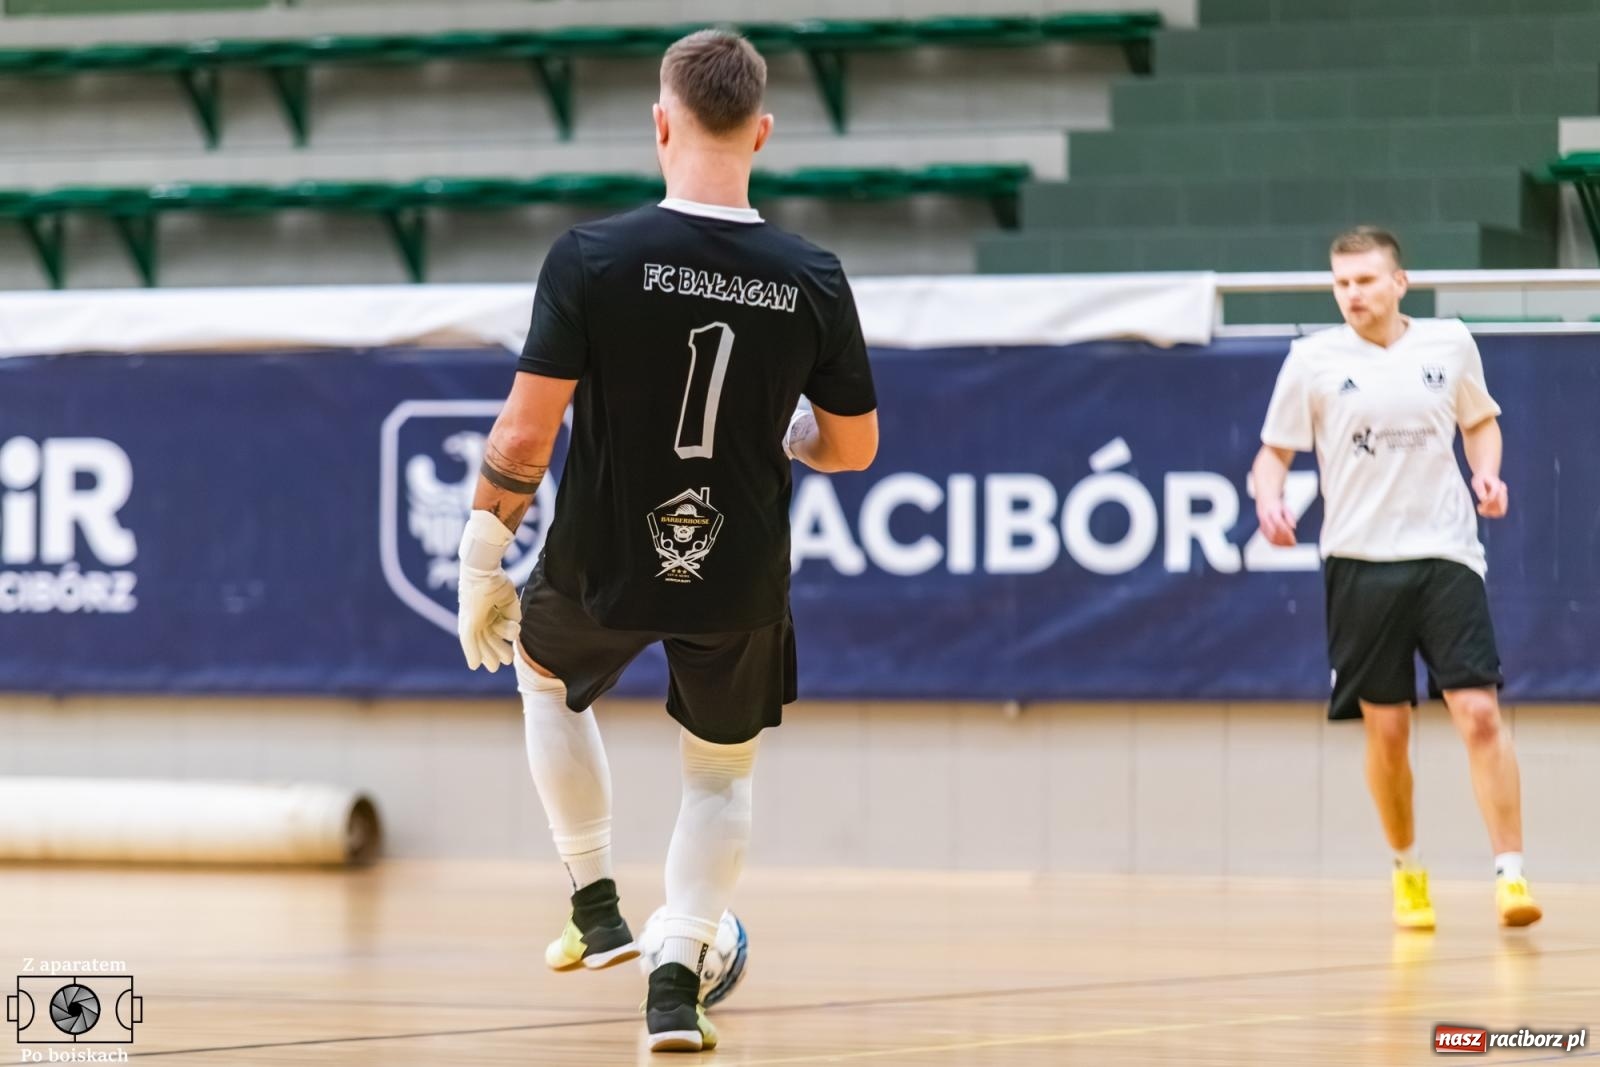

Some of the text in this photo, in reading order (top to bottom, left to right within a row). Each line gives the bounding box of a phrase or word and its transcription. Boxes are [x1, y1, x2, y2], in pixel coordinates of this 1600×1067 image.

[643, 263, 798, 313] FC BAŁAGAN
[674, 321, 735, 459] 1
[660, 516, 710, 525] BARBERHOUSE
